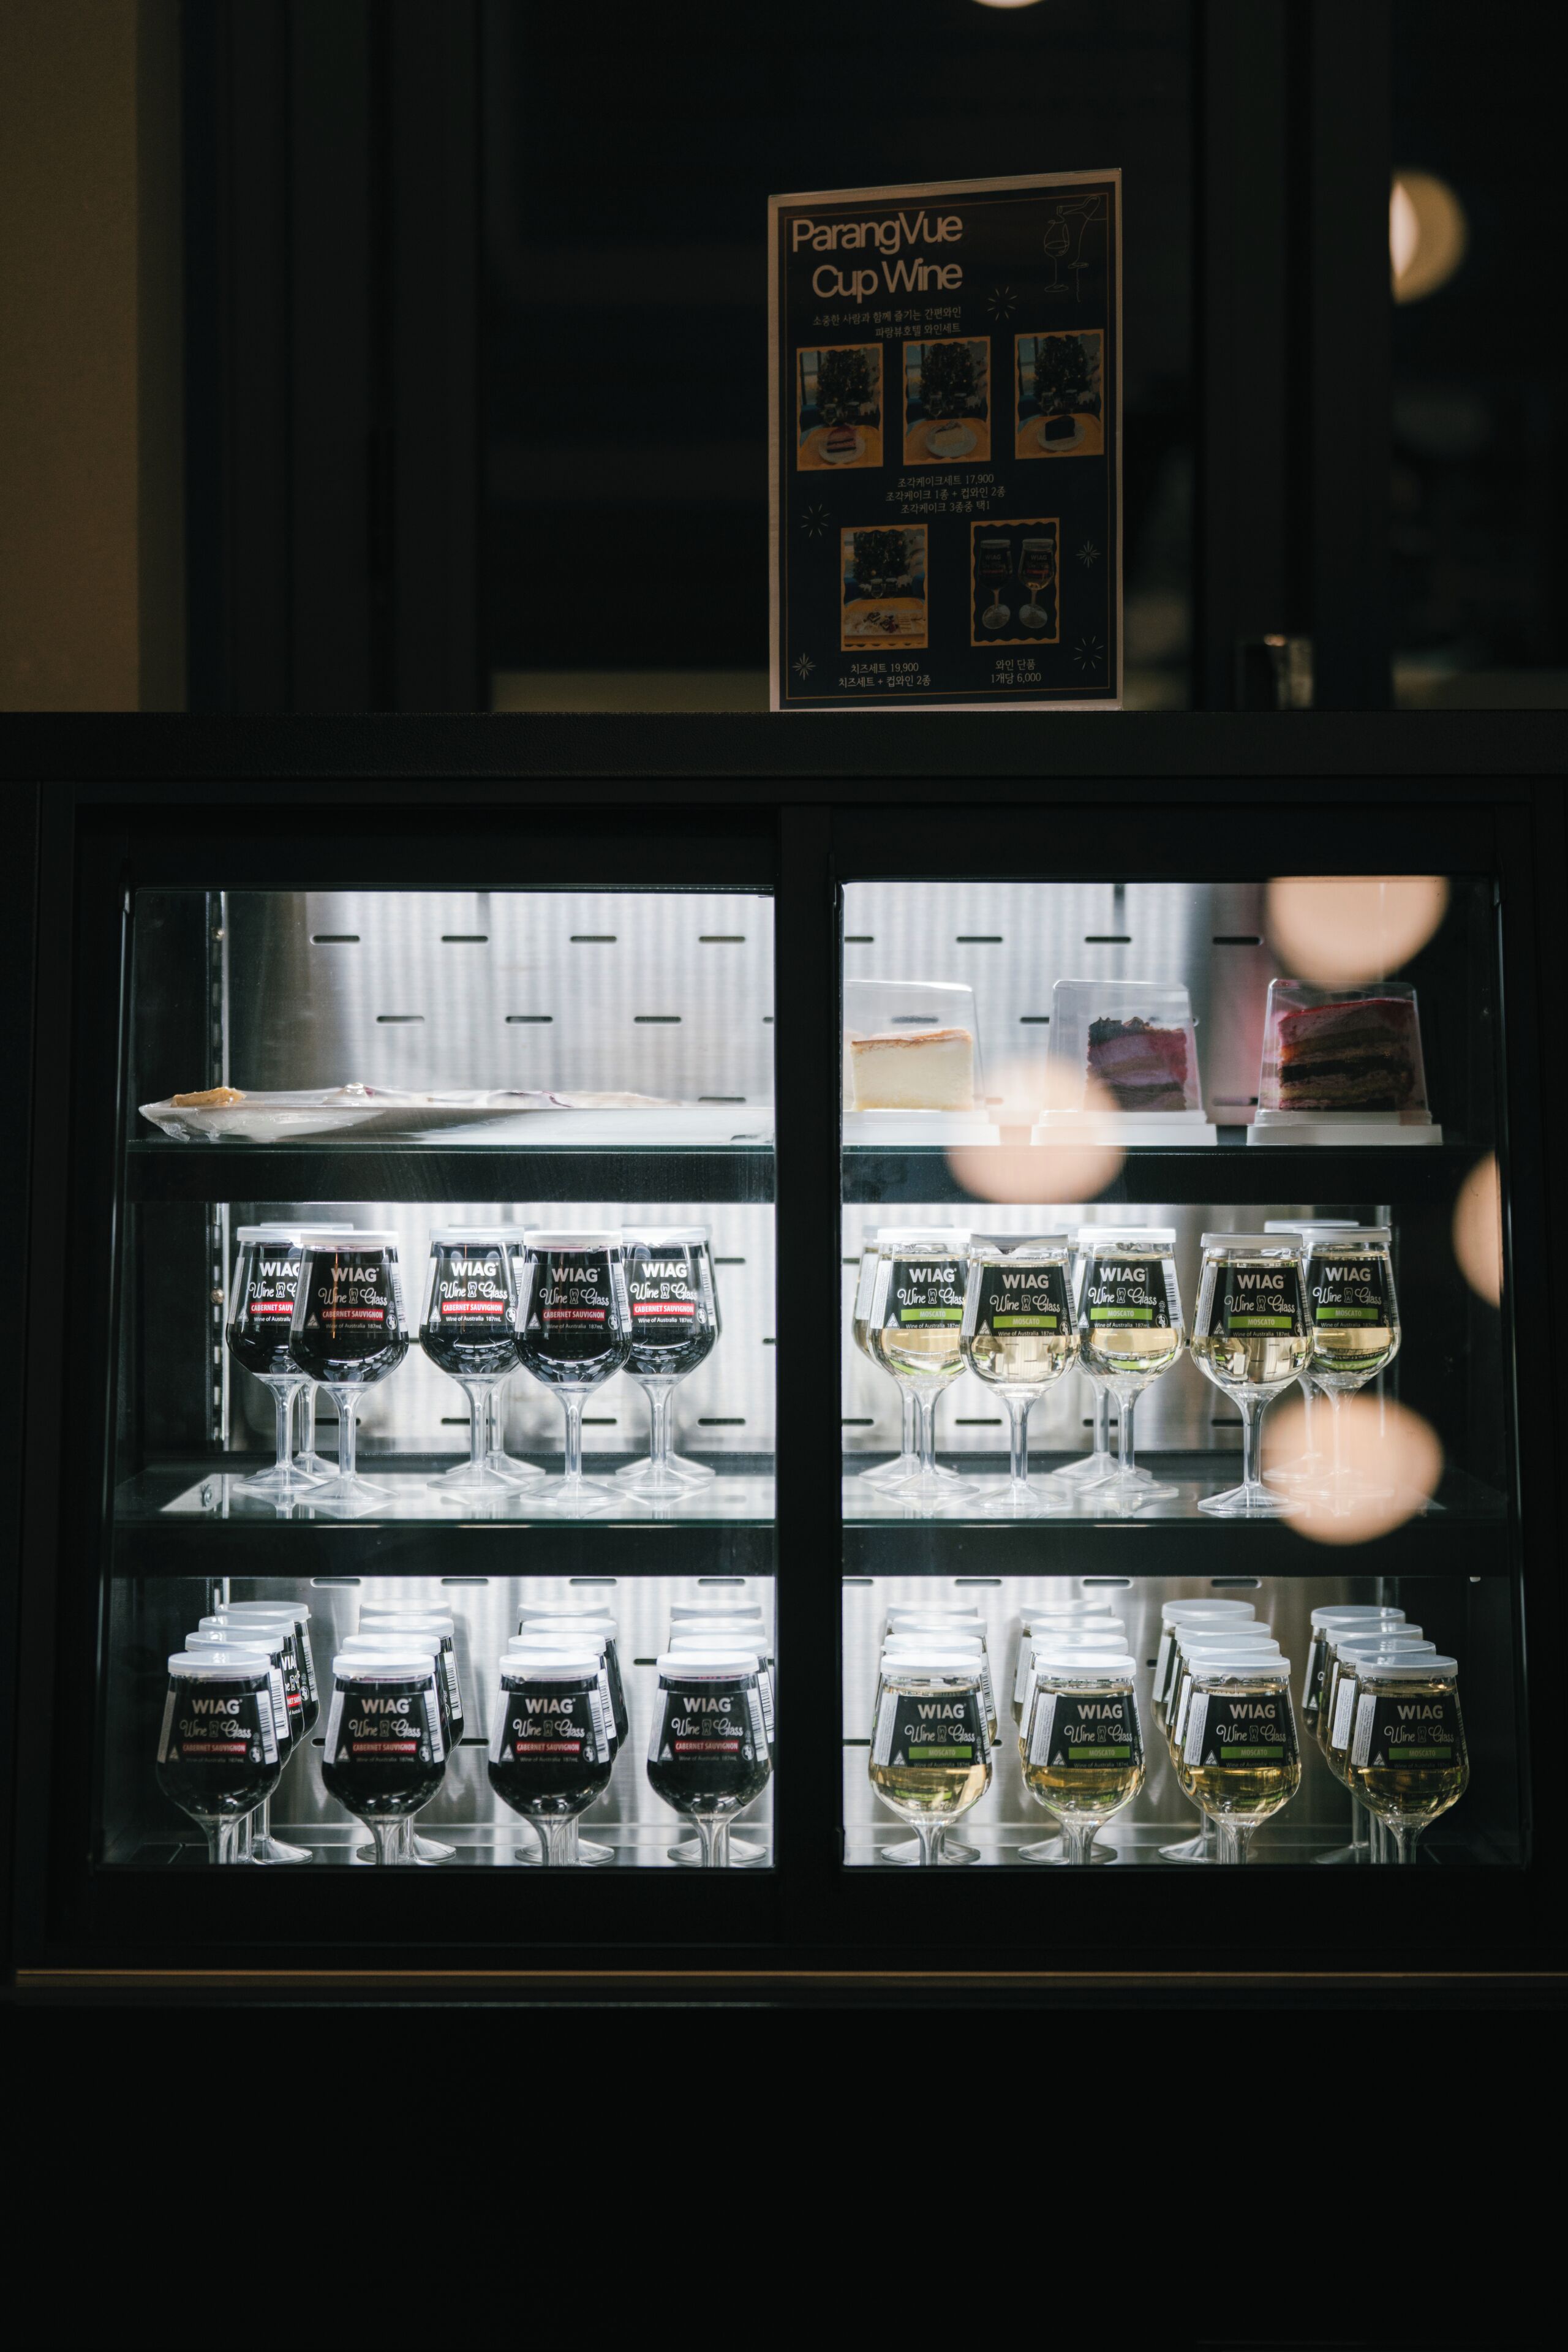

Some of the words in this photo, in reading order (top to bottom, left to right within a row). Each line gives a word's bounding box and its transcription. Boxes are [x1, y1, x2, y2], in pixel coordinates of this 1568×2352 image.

[791, 211, 963, 255] ParangVue
[812, 264, 879, 304] Cup
[881, 258, 963, 295] Wine
[813, 313, 840, 327] 소중한
[842, 312, 870, 325] 사람과
[872, 309, 891, 323] 함께
[894, 309, 921, 321] 즐기는
[924, 306, 962, 320] 간편와인
[875, 324, 921, 339] 파랑뷰호텔
[923, 322, 962, 336] 와인세트
[896, 474, 962, 488] 조각케이크세트
[965, 473, 995, 485] 17,900
[885, 489, 932, 502] 조각케이크
[934, 488, 949, 500] 1종
[960, 487, 989, 499] 컵와인
[991, 486, 1007, 498] 2종
[900, 502, 946, 514] 조각케이크
[949, 501, 974, 513] 3종중
[976, 499, 991, 512] 택1
[850, 662, 888, 674] 치즈세트
[890, 662, 919, 673] 19,900
[995, 659, 1015, 671] 와인
[1016, 658, 1036, 671] 단품
[838, 675, 876, 688] 치즈세트
[886, 674, 914, 687] 컵와인
[916, 674, 931, 687] 2종
[990, 673, 1015, 684] 1개당
[1016, 671, 1042, 684] 6,000
[331, 1268, 376, 1282] WIAG
[451, 1262, 496, 1276] WIAG
[552, 1268, 598, 1283] WIAG
[643, 1264, 687, 1278] WIAG
[909, 1268, 955, 1283] WIAG
[1099, 1268, 1145, 1281] WIAG
[1325, 1268, 1371, 1281] WIAG
[249, 1282, 274, 1298] Wine
[440, 1281, 466, 1298] Wine
[478, 1281, 507, 1299] Glass
[1003, 1275, 1049, 1289] WIAG
[1237, 1275, 1284, 1289] WIAG
[318, 1287, 347, 1305] Wine
[360, 1287, 387, 1305] Glass
[540, 1287, 567, 1305] Wine
[581, 1288, 609, 1305] Glass
[630, 1283, 658, 1300] Wine
[671, 1283, 697, 1300] Glass
[897, 1289, 925, 1305] Wine
[1088, 1287, 1114, 1304] Wine
[1128, 1287, 1156, 1305] Glass
[1313, 1287, 1341, 1303] Wine
[1355, 1287, 1381, 1304] Glass
[990, 1294, 1019, 1312] Wine
[1033, 1295, 1060, 1313] Glass
[1224, 1295, 1254, 1313] Wine
[1268, 1295, 1295, 1313] Glass
[192, 1699, 239, 1714] WIAG
[361, 1699, 409, 1714] WIAG
[526, 1698, 573, 1714] WIAG
[684, 1698, 731, 1713] WIAG
[918, 1704, 964, 1719] WIAG
[1077, 1705, 1122, 1719] WIAG
[1230, 1704, 1275, 1719] WIAG
[1397, 1705, 1443, 1720] WIAG
[180, 1720, 207, 1737] Wine
[221, 1720, 251, 1738] Glass
[349, 1719, 377, 1737] Wine
[391, 1719, 421, 1738] Glass
[513, 1719, 541, 1737] Wine
[555, 1719, 584, 1738] Glass
[671, 1717, 699, 1736] Wine
[713, 1717, 743, 1736] Glass
[905, 1724, 935, 1743] Wine
[949, 1724, 974, 1743] Glass
[1065, 1725, 1095, 1743] Wine
[1108, 1725, 1132, 1743] Glass
[1216, 1725, 1247, 1743] Wine
[1261, 1725, 1286, 1743] Glass
[1384, 1726, 1415, 1744] Wine
[1428, 1725, 1454, 1743] Glass
